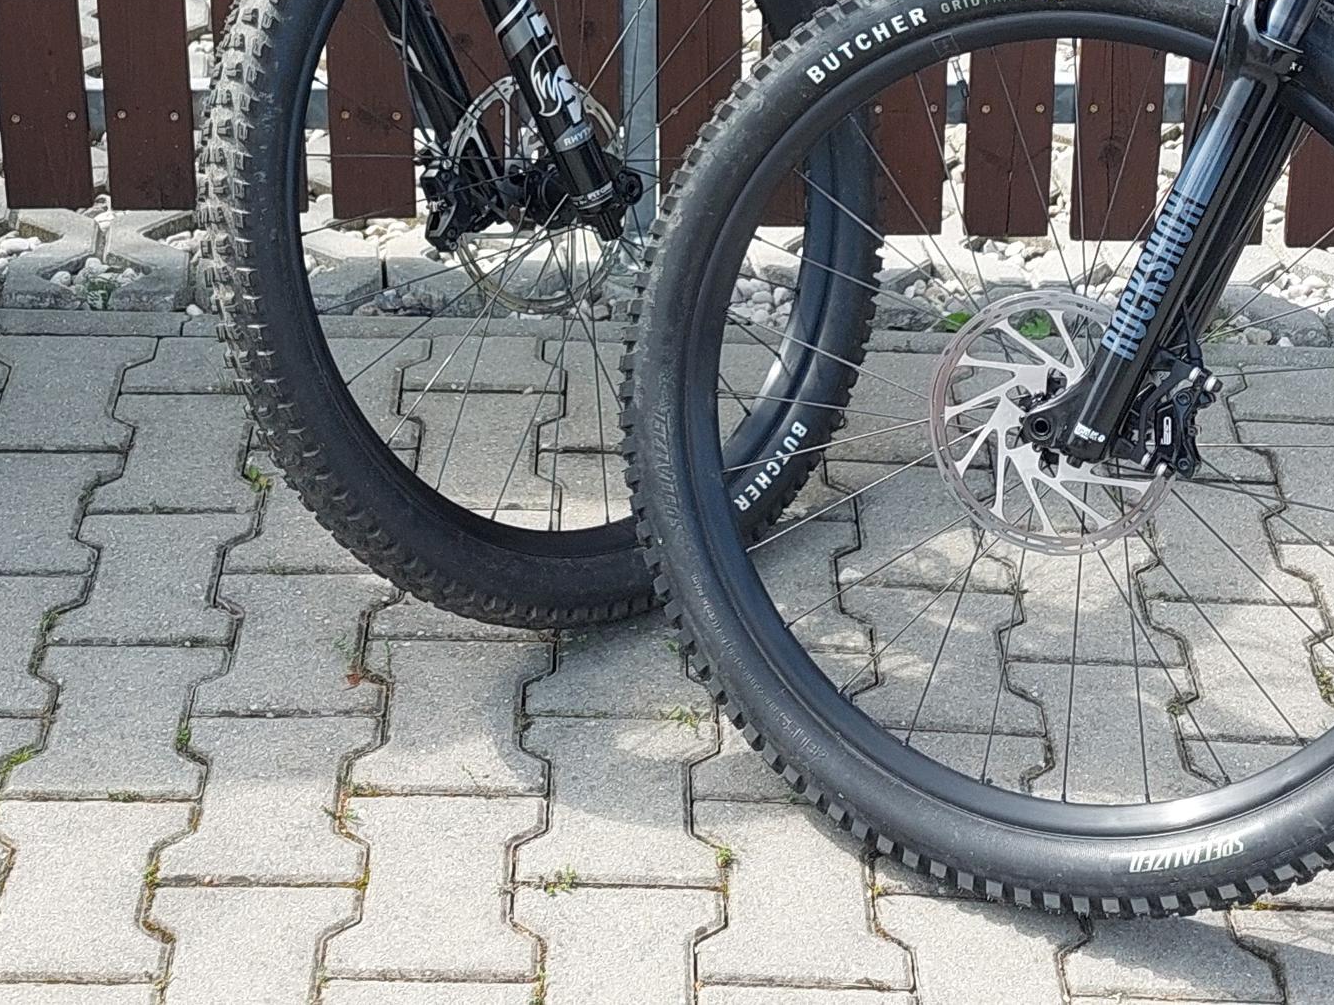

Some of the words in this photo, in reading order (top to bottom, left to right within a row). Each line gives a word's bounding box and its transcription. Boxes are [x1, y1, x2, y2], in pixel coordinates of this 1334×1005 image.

[805, 6, 929, 86] BUTCHER
[1101, 189, 1206, 362] ROCKSHOX
[733, 421, 809, 512] BUTCHER
